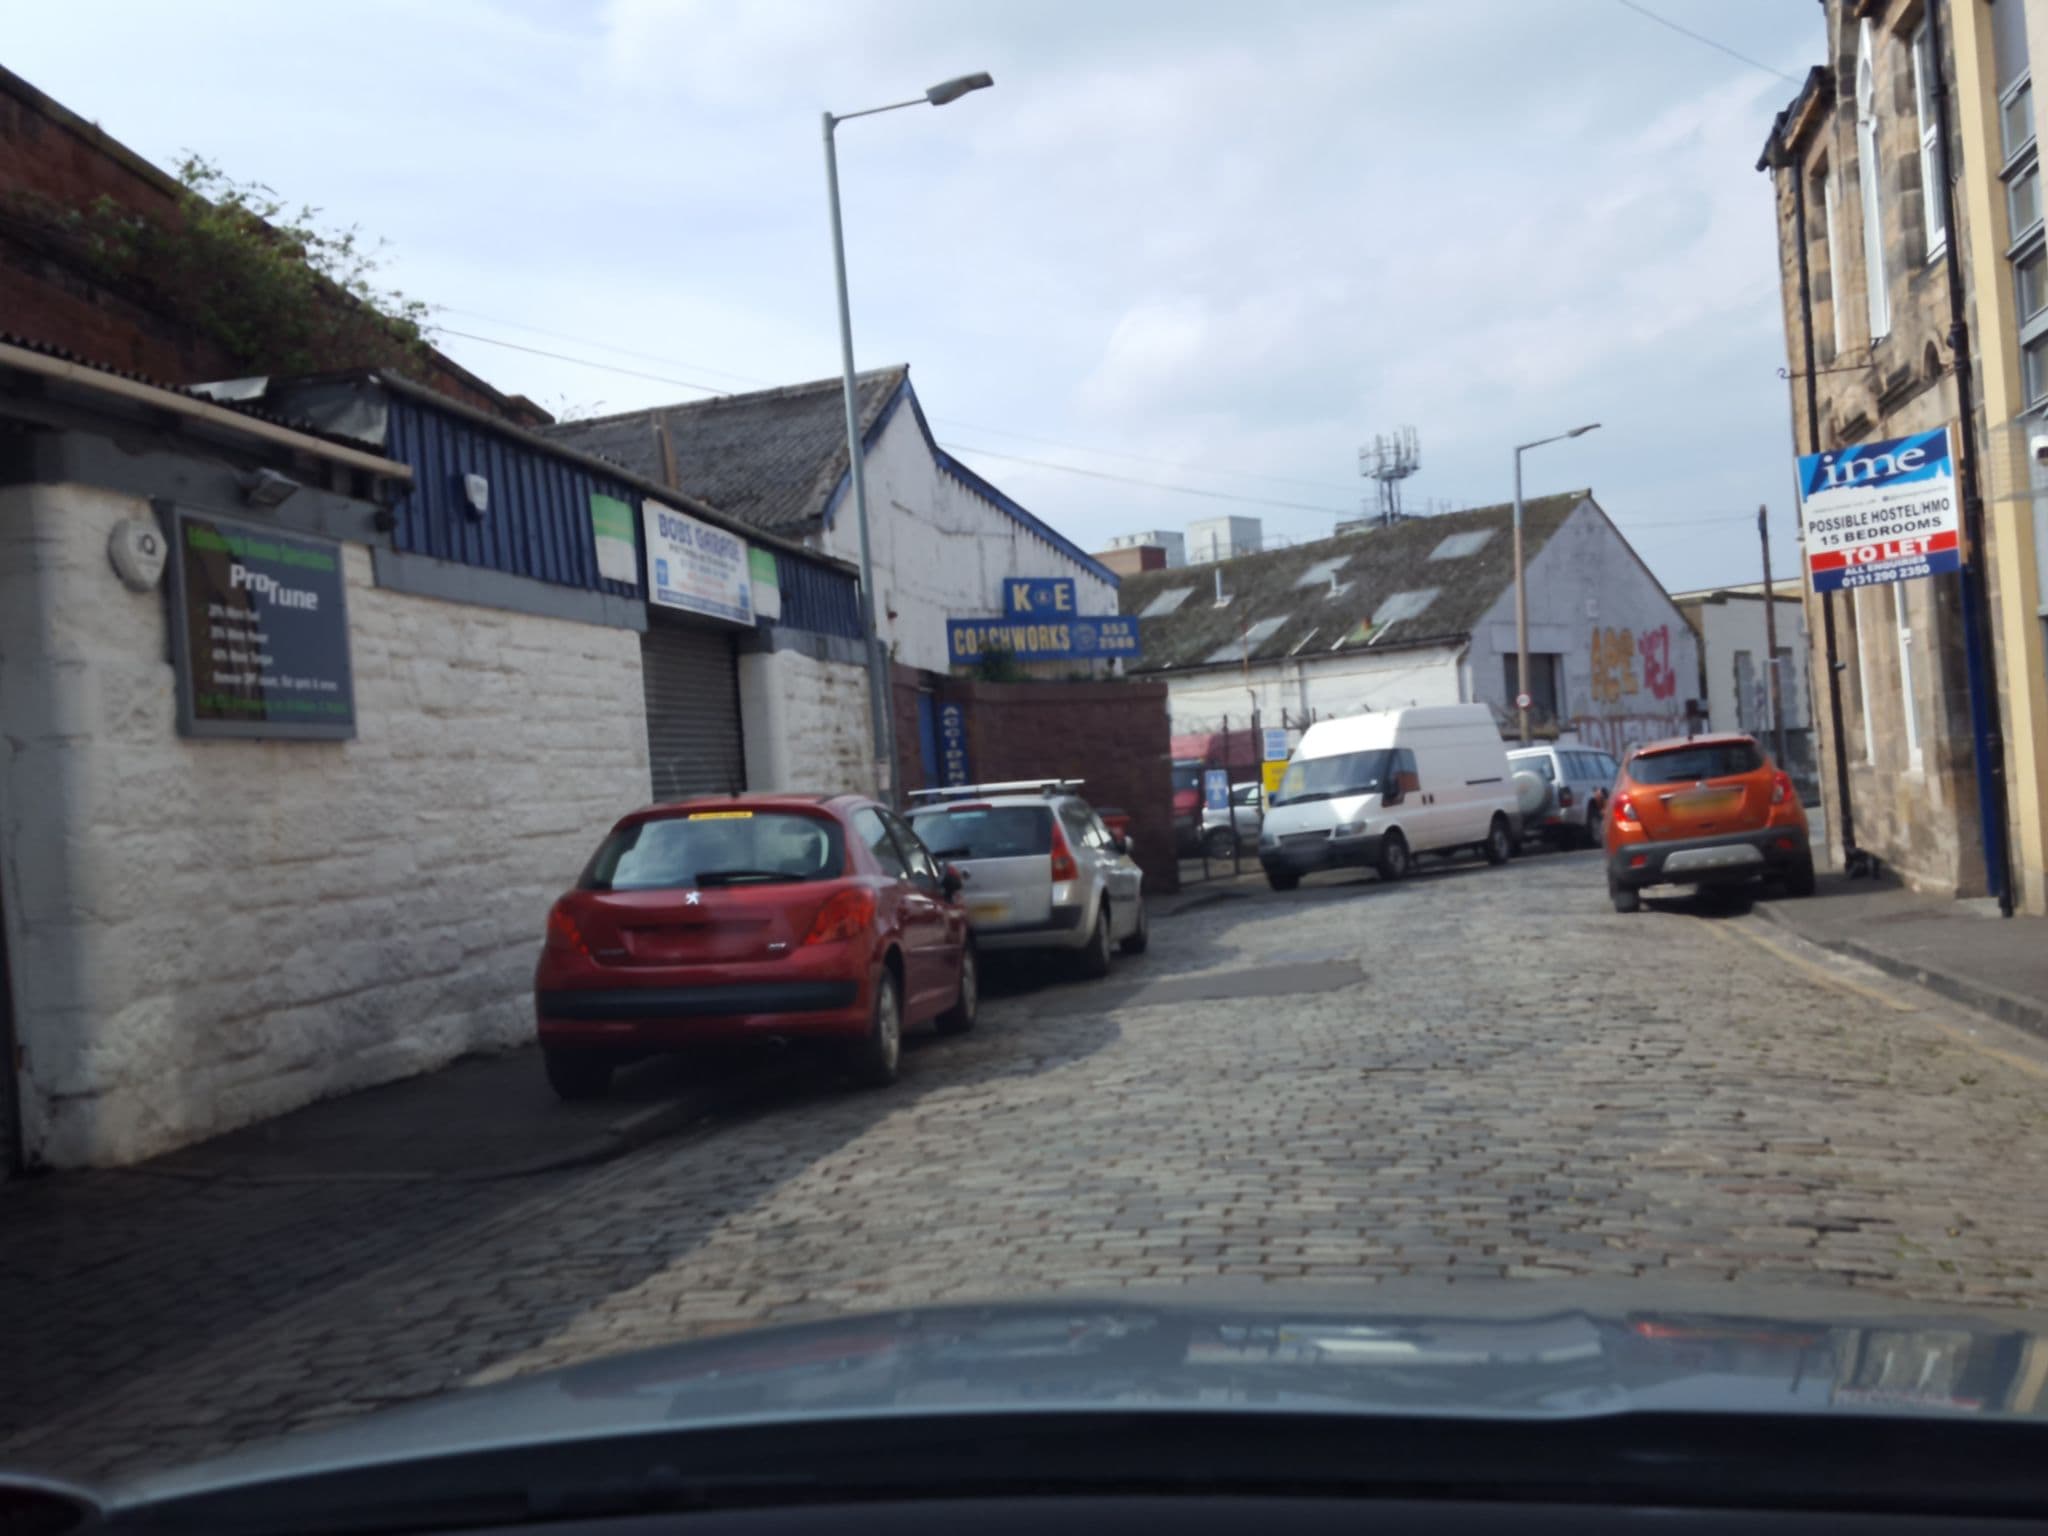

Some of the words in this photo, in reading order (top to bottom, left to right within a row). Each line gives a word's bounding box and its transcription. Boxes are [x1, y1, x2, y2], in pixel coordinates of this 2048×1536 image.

[1823, 447, 1926, 487] ime
[1809, 511, 1868, 534] POSSIBLE
[1821, 535, 1840, 546] 15
[1844, 516, 1942, 543] BEDROOMS
[1840, 545, 1877, 566] TO
[1883, 535, 1932, 559] LET
